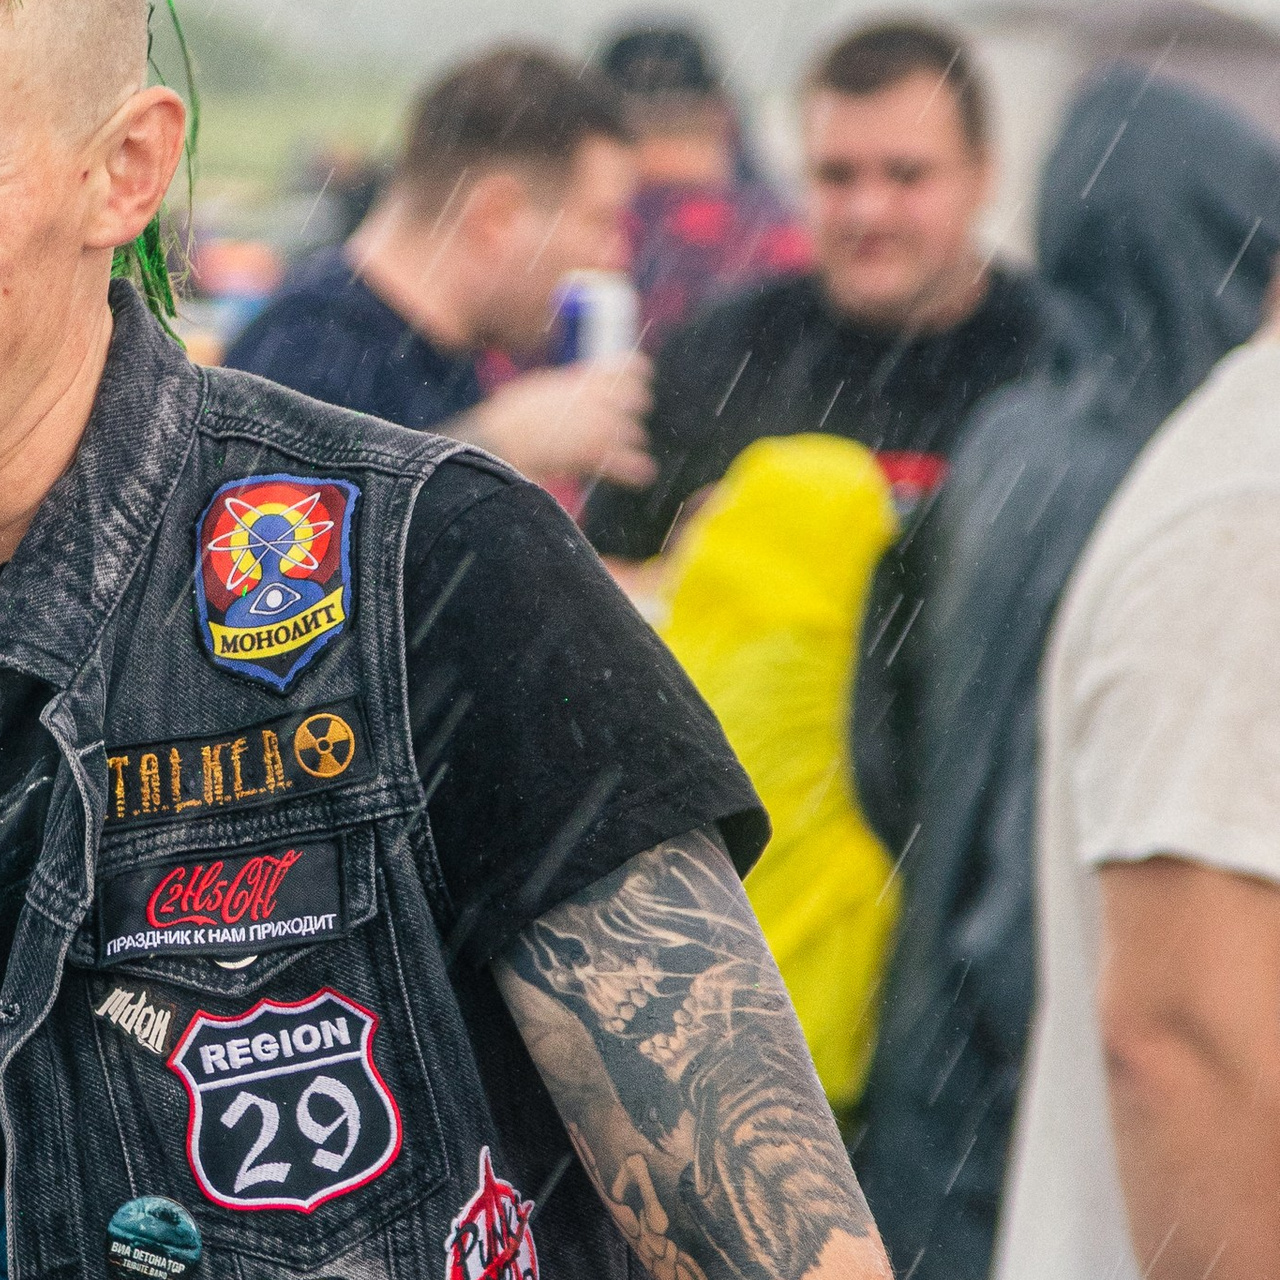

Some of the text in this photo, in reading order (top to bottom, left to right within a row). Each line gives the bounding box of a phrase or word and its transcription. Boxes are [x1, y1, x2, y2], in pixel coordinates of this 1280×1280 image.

[220, 603, 337, 654] МОНОЛИТ
[106, 913, 338, 956] ПРАЗДНИК К НАМ ПРИХОДИТ
[199, 1017, 352, 1075] REGION
[220, 1075, 361, 1194] 29
[122, 1258, 168, 1280] TRIBUTE BAND
